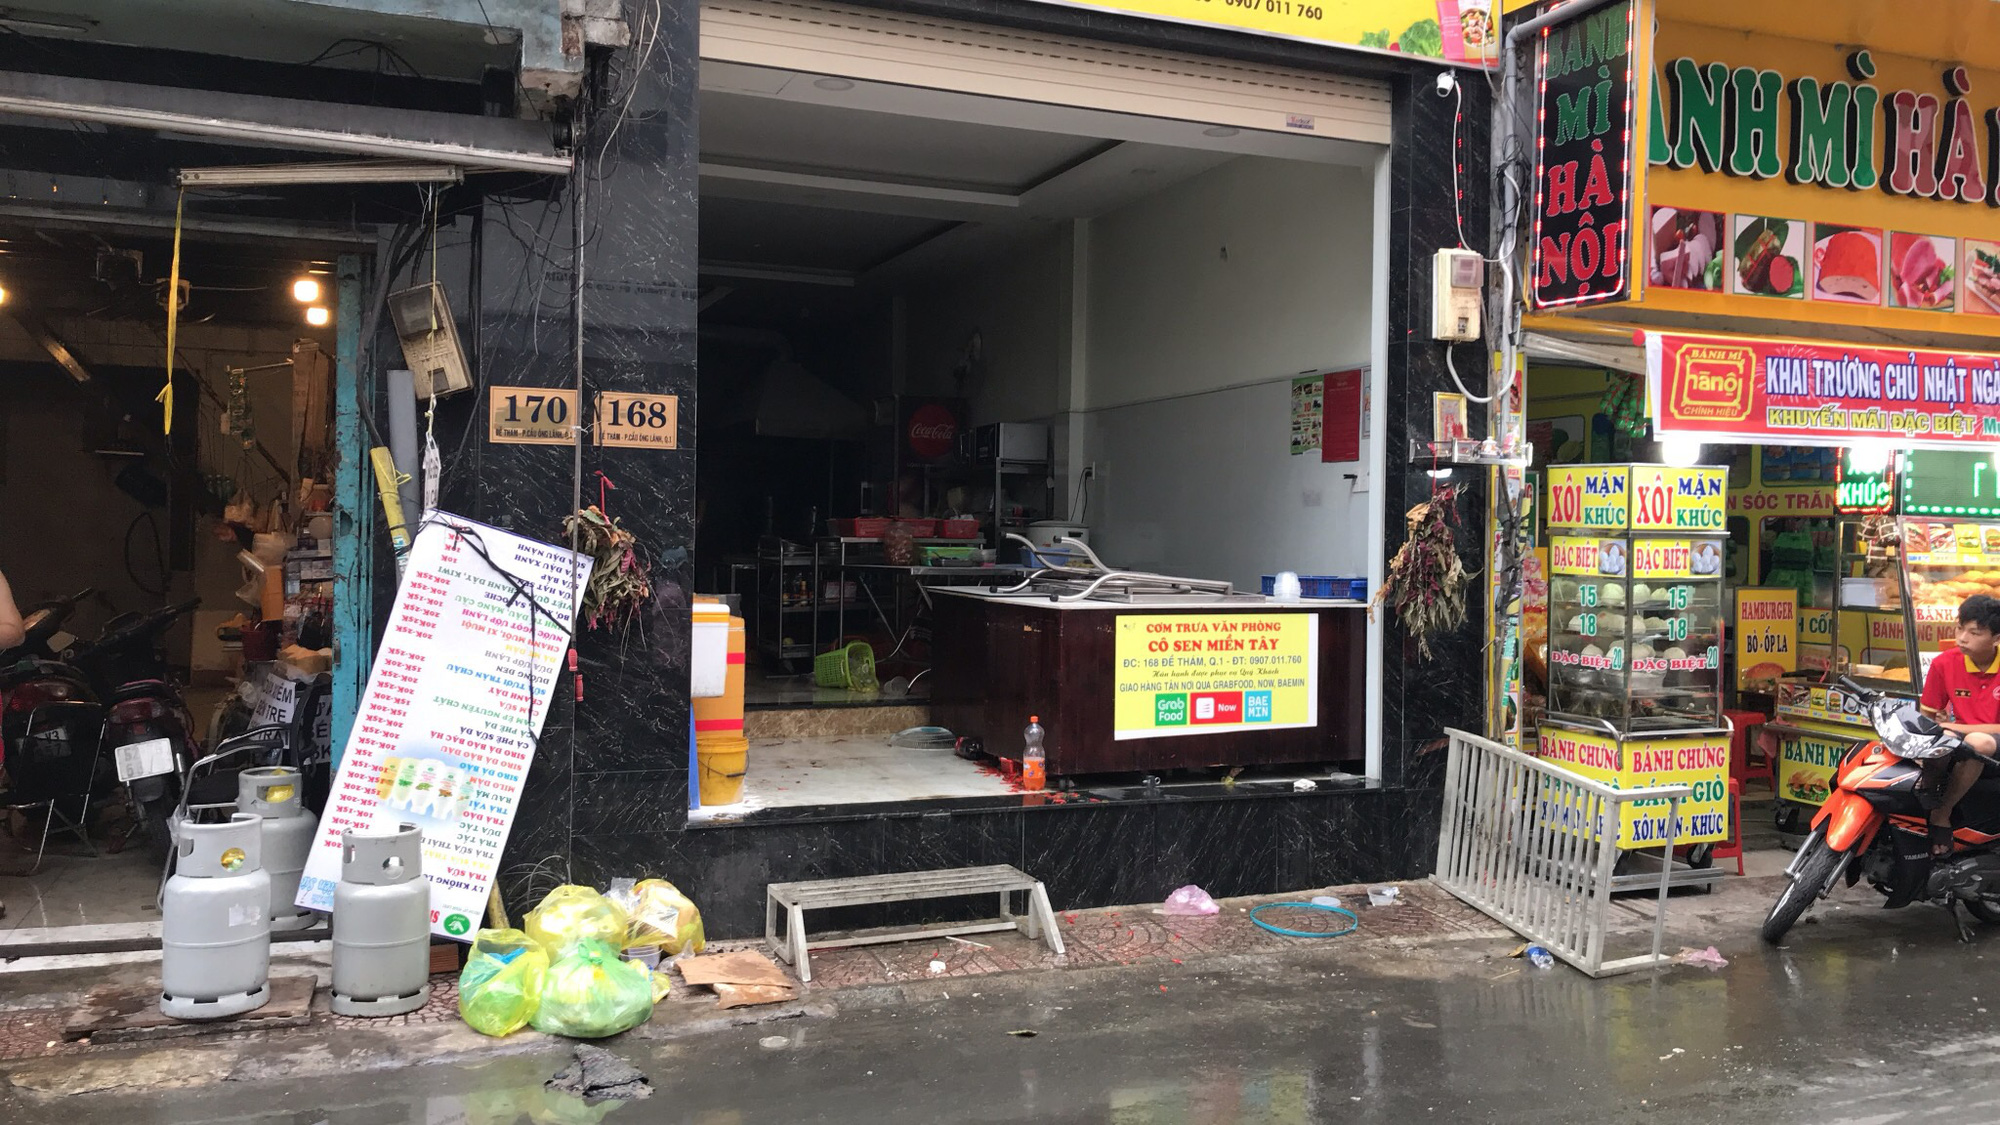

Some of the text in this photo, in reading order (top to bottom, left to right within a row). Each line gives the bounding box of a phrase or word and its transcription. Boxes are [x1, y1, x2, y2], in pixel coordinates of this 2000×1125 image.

[1266, 1, 1290, 15] 011
[1297, 4, 1323, 20] 760
[1795, 50, 1879, 190] MÌ
[1890, 67, 1986, 201] HÀ
[1540, 211, 1619, 295] NỘI
[1691, 348, 1726, 360] BÁNH
[1766, 357, 1810, 395] KHAI
[1812, 355, 1881, 399] TRƯƠNG
[1885, 353, 1919, 402] CHỦ
[1924, 357, 1967, 410] NHẬT
[504, 394, 567, 424] 170
[608, 400, 667, 428] 168
[1683, 404, 1714, 415] CHÍNH
[1766, 404, 1848, 431] KHUYẾN
[1850, 408, 1888, 433] MÃI
[1890, 414, 1930, 437] ĐẶC
[1932, 414, 1975, 437] BIỆT
[1552, 473, 1581, 523] XÔI
[1585, 470, 1625, 498] MẶN
[1636, 473, 1722, 524] XÔI MẶN
[1743, 490, 1778, 510] SÓC
[1839, 477, 1890, 506] KHÚC
[1584, 502, 1625, 525] KHÚC
[1676, 503, 1722, 527] KHÚC
[439, 553, 457, 564] 10K
[513, 553, 541, 566] XANH
[1554, 540, 1598, 573] ĐẶC BIỆT
[1636, 541, 1689, 575] ĐẶC BIỆT
[436, 565, 461, 577] KIWI
[409, 580, 447, 596] 20K-25K
[1579, 585, 1597, 607] 15
[405, 591, 443, 607] 10K-15K
[1668, 587, 1687, 610] 15
[461, 606, 489, 621] LẠNH
[1741, 602, 1793, 620] HAMBURGER
[402, 602, 560, 653] CHANH MUỘI 20K-25K
[1146, 620, 1282, 633] CƠM TRƯA VĂN PHÒNG
[1579, 613, 1597, 636] 18
[1668, 617, 1688, 641] 18
[1873, 618, 1901, 638] BÁNH
[394, 624, 511, 662] LẠNH 20K-25K
[1148, 634, 1280, 653] CÔ SEN MIỀN TÂY
[1747, 625, 1788, 653] BÒ ỐP LA
[387, 646, 425, 661] 20K-25K
[1123, 658, 1141, 668] ĐC:
[1144, 658, 1159, 668] 168
[1209, 656, 1224, 667] Q.1
[1232, 656, 1248, 666] ĐT:
[1249, 655, 1302, 665] 0907.011.760
[1552, 647, 1623, 671] ĐẶC BIỆT 20
[1632, 646, 1719, 673] ĐẶC BIỆT 20
[383, 657, 422, 673] 15K-20K
[379, 668, 418, 684] 20K-25K
[1120, 682, 1139, 692] GIAO
[1140, 680, 1162, 692] HÀNG
[1196, 680, 1211, 691] QUA
[1213, 679, 1255, 690] GRABFOOD,
[1257, 679, 1276, 690] NOW,
[1277, 678, 1305, 688] BAEMIN
[376, 679, 414, 695] 20K-25K
[372, 691, 411, 706] 15K-20K
[1157, 698, 1185, 711] Grab
[1218, 703, 1237, 712] Now
[1248, 695, 1268, 707] BAE
[368, 702, 407, 717] 15K-20K
[459, 702, 501, 720] NGUYÊN
[1158, 709, 1184, 721] Food
[1248, 706, 1269, 717] MIN
[364, 713, 526, 760] SIRO BẠC 20K-25K
[361, 724, 522, 771] SIRO 20K-25K
[1541, 733, 1622, 773] BÁNH CHƯNG
[1633, 742, 1725, 773] BÁNH CHƯNG
[357, 735, 519, 782] SIRO 20K-25K
[353, 747, 515, 792] MILO 25K
[473, 789, 512, 803] RAU MÁ
[1691, 774, 1725, 803] GIÒ
[338, 793, 378, 807] 15K-20K
[334, 804, 374, 818] 10K-15K
[330, 816, 370, 830] 15K-20K
[1633, 813, 1654, 842] XÔI
[1691, 808, 1724, 837] KHÚC
[471, 884, 484, 892] LY
